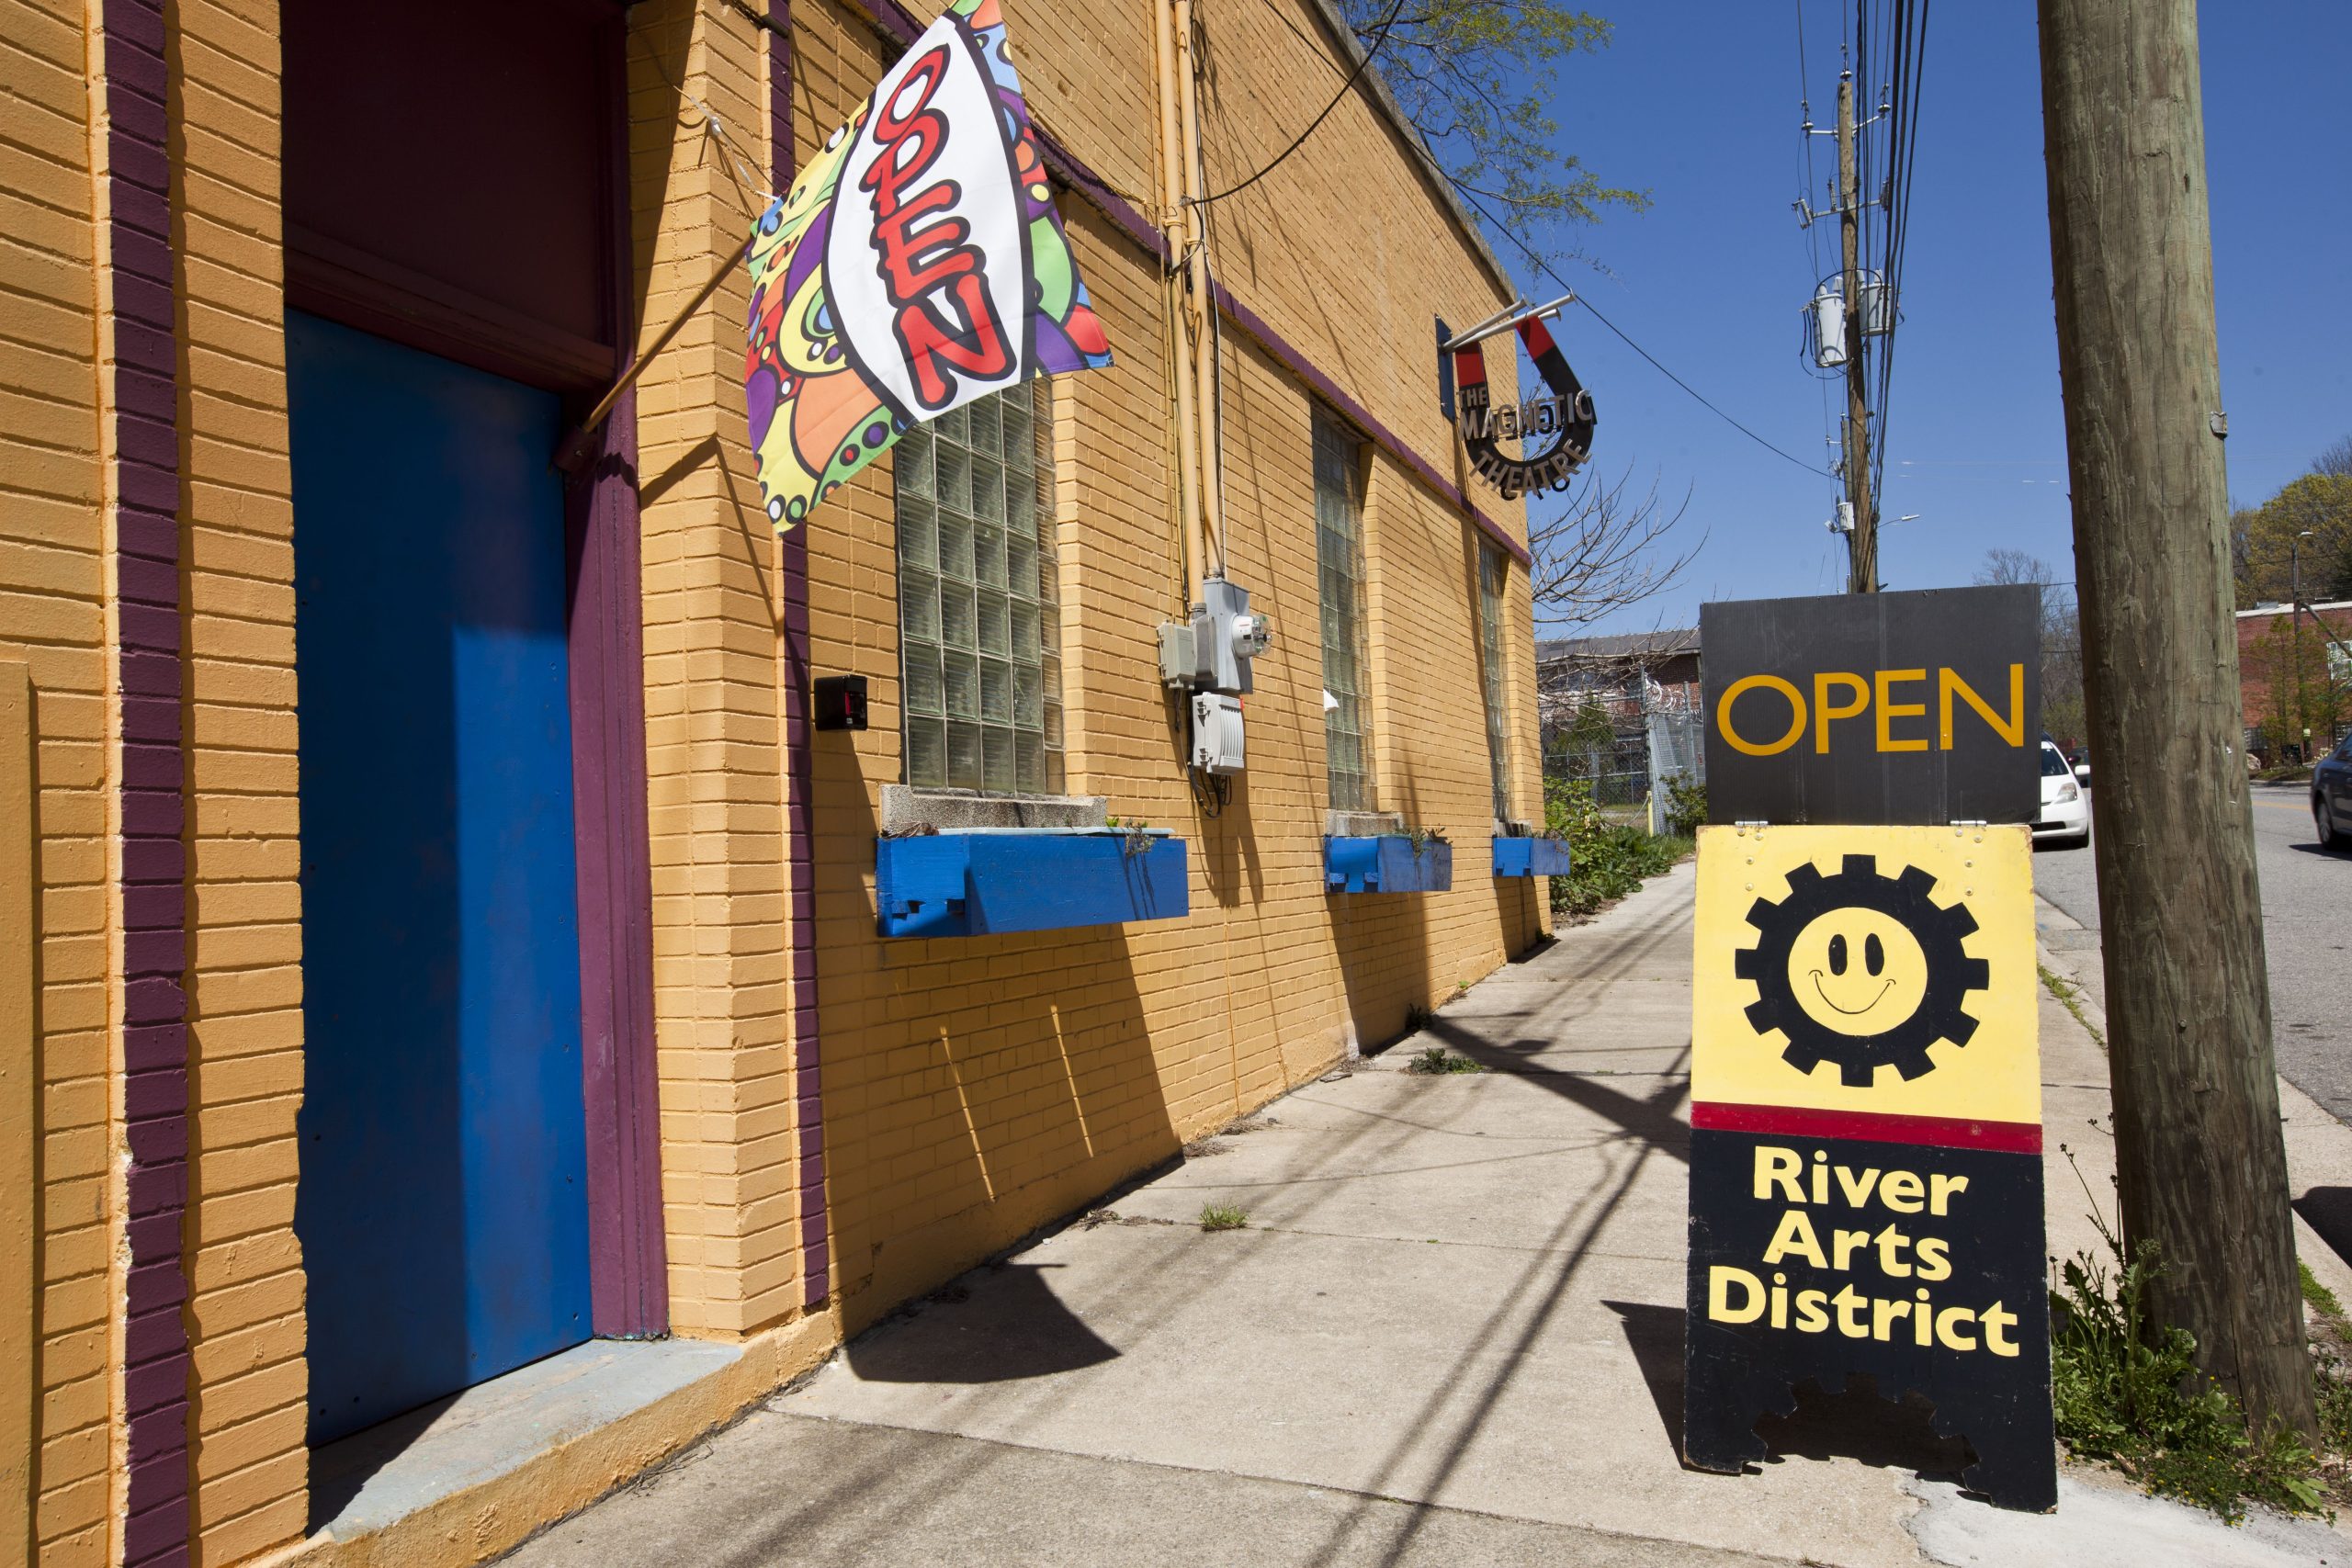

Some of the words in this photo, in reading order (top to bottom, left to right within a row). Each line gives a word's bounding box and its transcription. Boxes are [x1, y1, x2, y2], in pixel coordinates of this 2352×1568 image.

[859, 43, 1017, 411] OPEN
[1457, 388, 1488, 409] THE
[1458, 389, 1593, 442] MAGNETIC
[1468, 437, 1592, 498] THEATRE
[1716, 663, 2024, 757] OPEN
[1753, 1145, 1970, 1217] River
[1762, 1210, 1952, 1281] Arts
[1708, 1265, 2020, 1358] District
